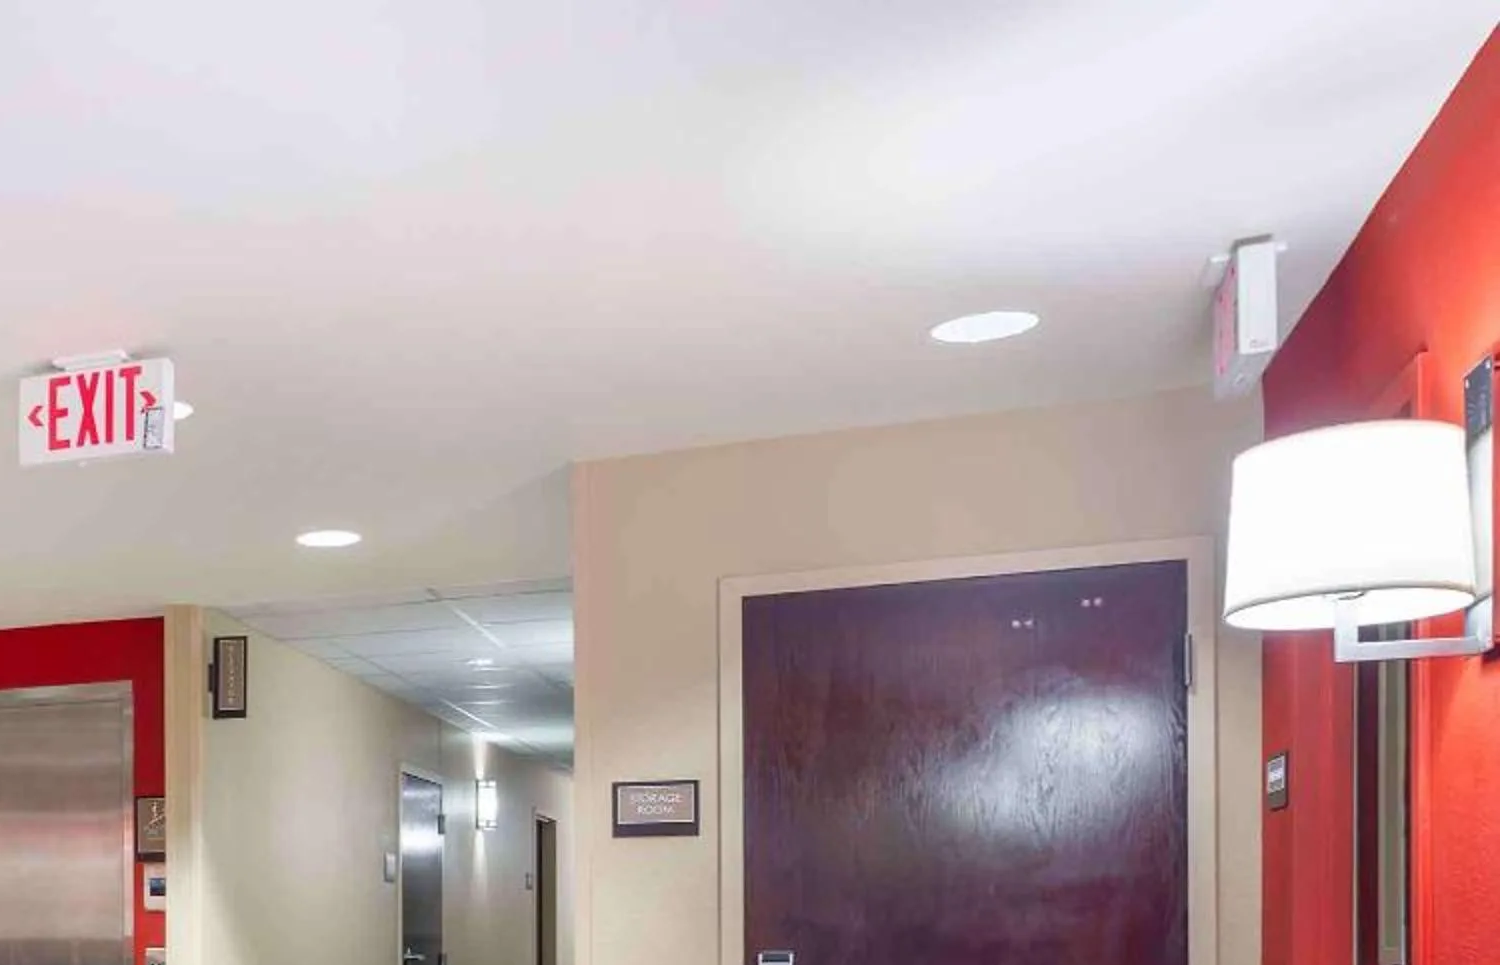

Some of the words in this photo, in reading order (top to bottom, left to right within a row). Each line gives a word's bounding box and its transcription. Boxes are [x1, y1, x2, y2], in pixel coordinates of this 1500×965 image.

[48, 366, 143, 451] EXIT
[630, 792, 684, 805] STORAGE
[637, 804, 676, 816] ROOM
